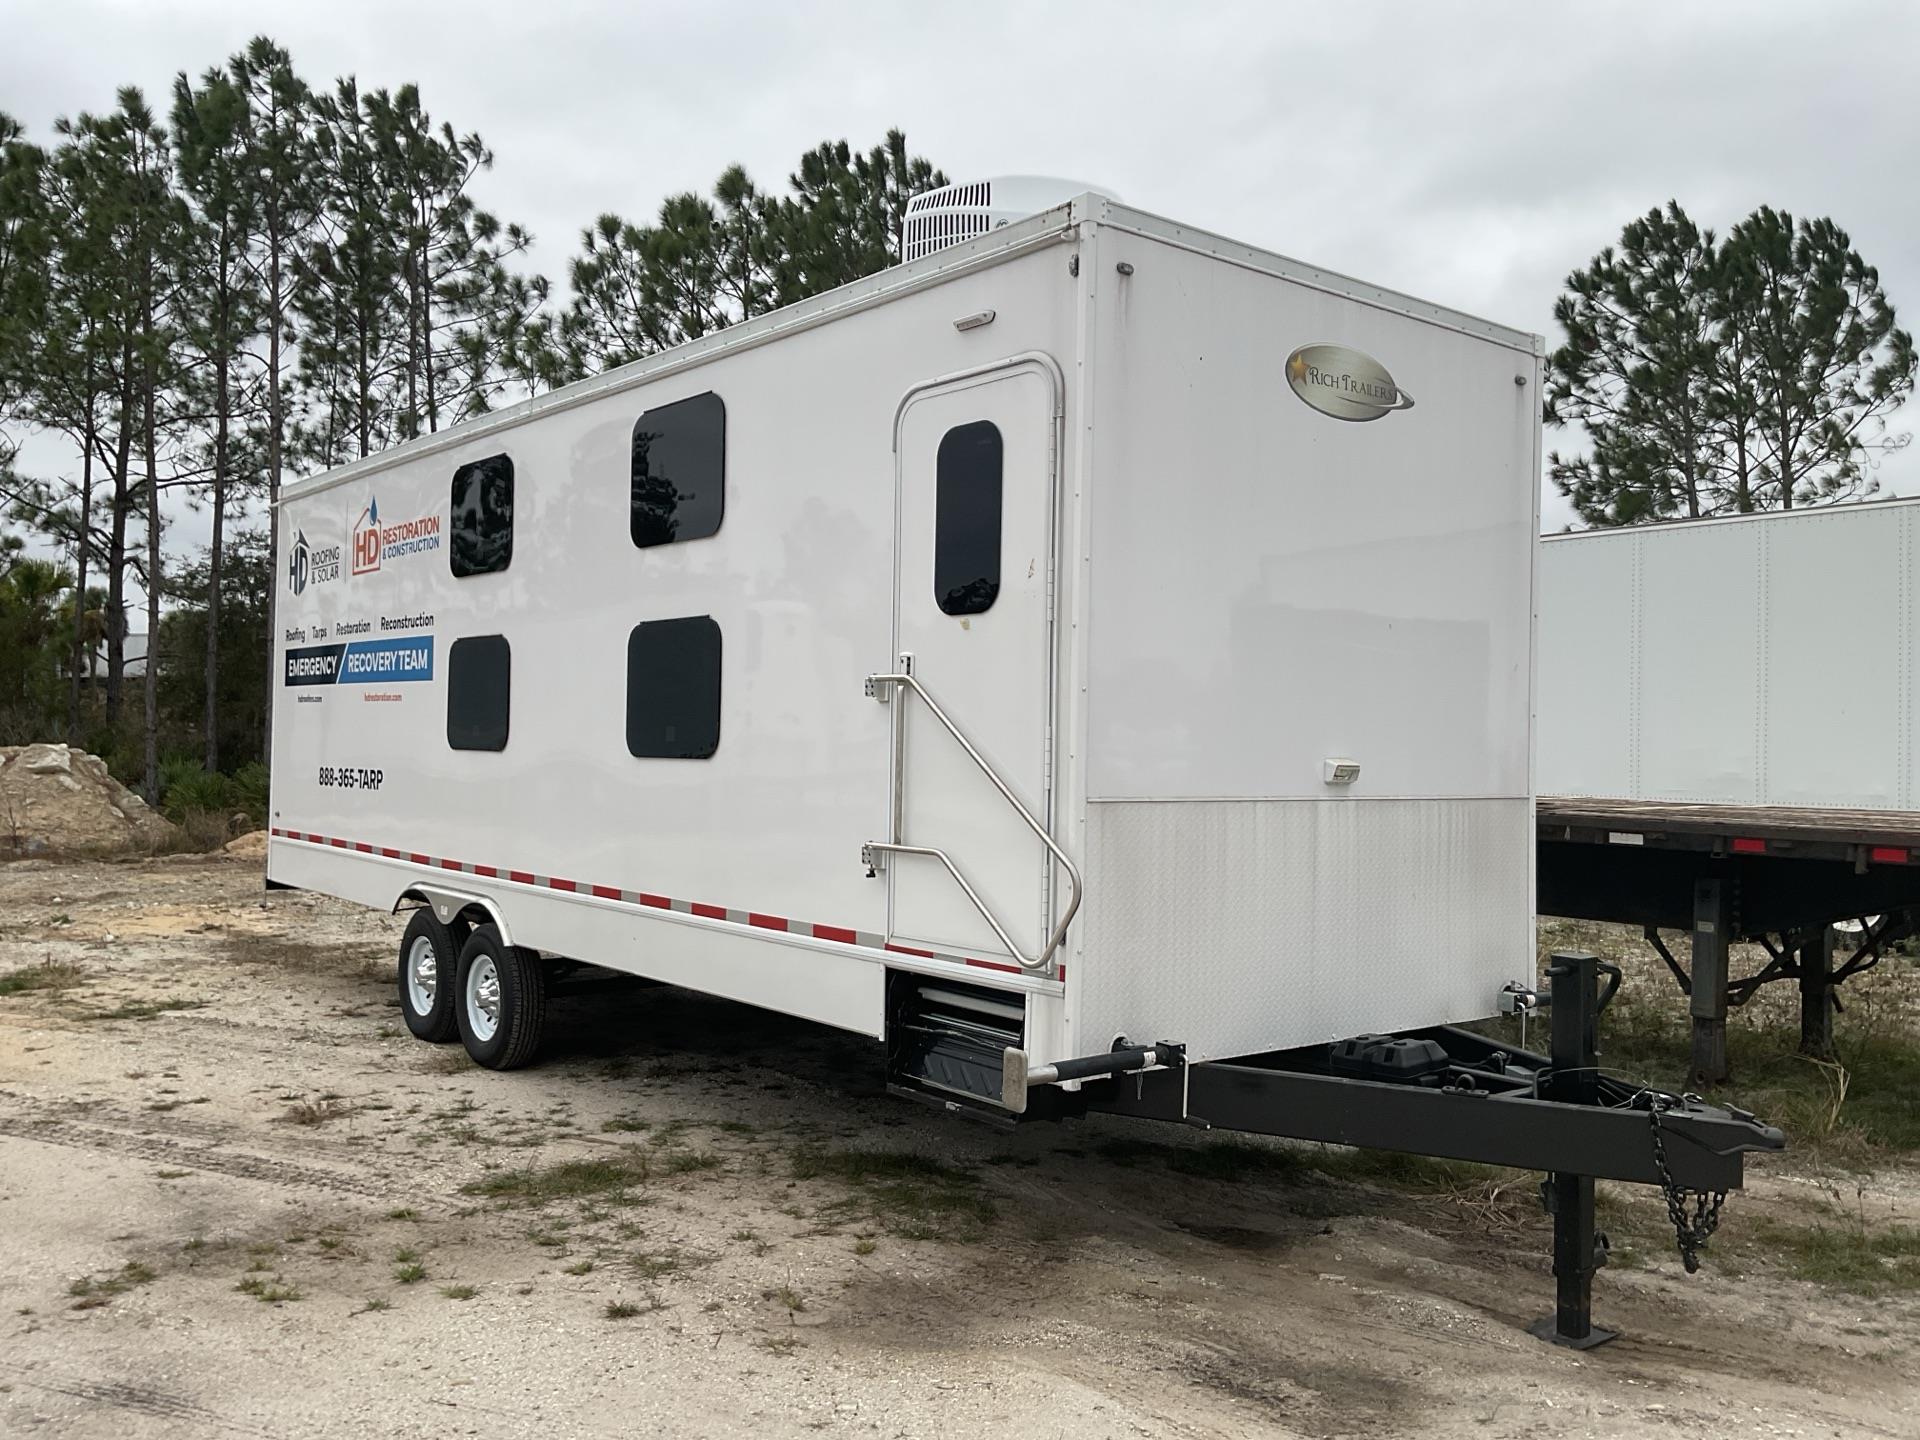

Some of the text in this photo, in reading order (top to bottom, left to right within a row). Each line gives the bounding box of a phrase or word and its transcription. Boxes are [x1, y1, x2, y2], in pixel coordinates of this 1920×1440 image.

[1309, 366, 1339, 389] RICH
[382, 515, 440, 546] RESTORATION
[311, 546, 340, 566] ROOFING
[355, 529, 379, 568] HD
[382, 536, 440, 560] & CONSTRUCTION
[311, 565, 340, 584] & SOLAR
[285, 611, 434, 643] Roofing Tarps Restoration Reconstruction
[288, 649, 428, 677] EMERGENCY RECOVERY TEAM
[319, 766, 384, 790] 888-365-TARP
